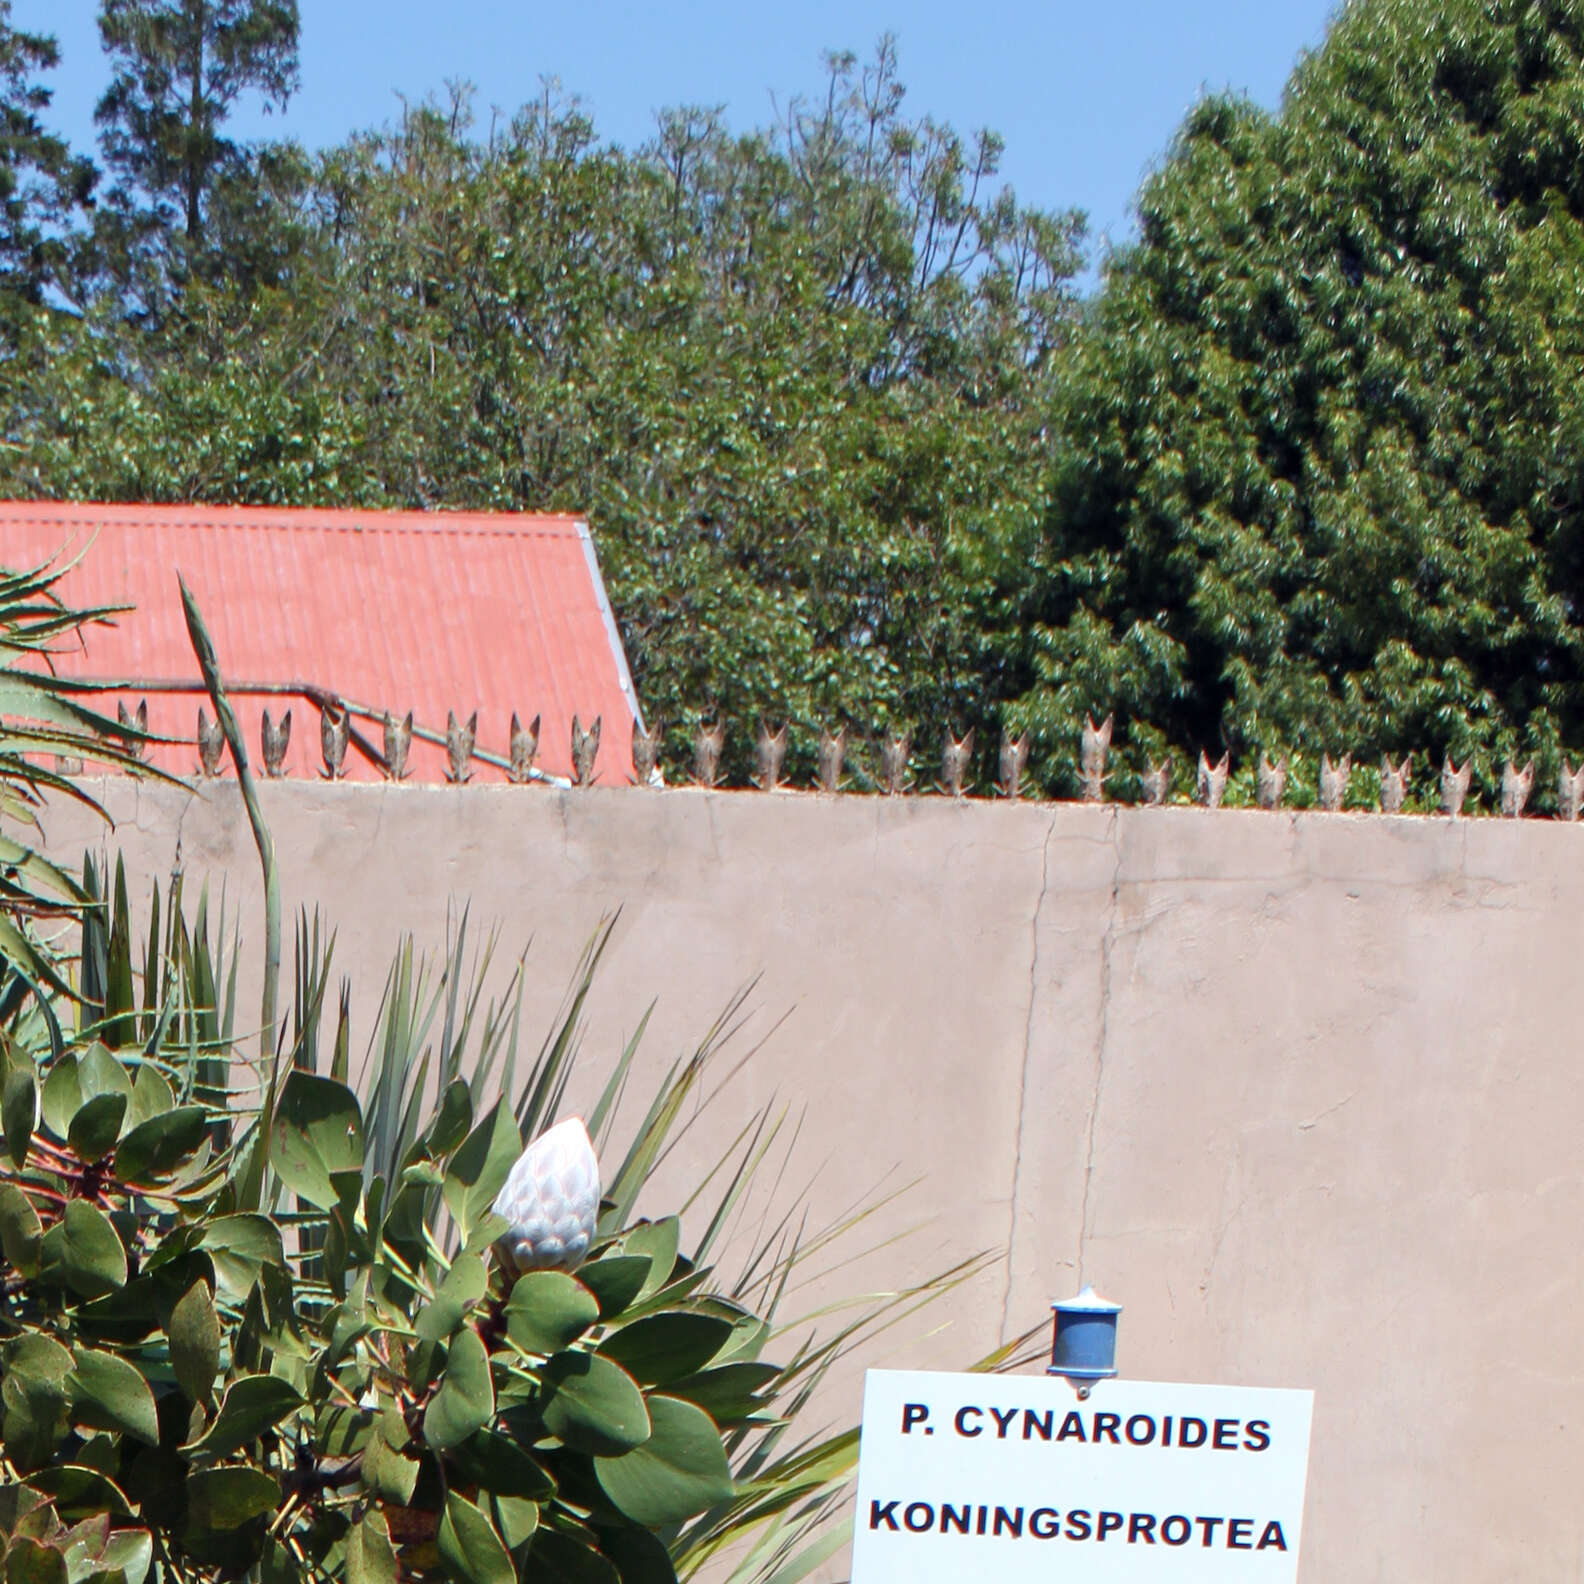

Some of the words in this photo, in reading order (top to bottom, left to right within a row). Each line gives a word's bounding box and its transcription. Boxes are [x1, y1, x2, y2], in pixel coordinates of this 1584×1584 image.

[902, 1403, 934, 1435] P.
[954, 1405, 1271, 1452] CYNAROIDES
[869, 1500, 1288, 1552] KONINGSPROTEA
